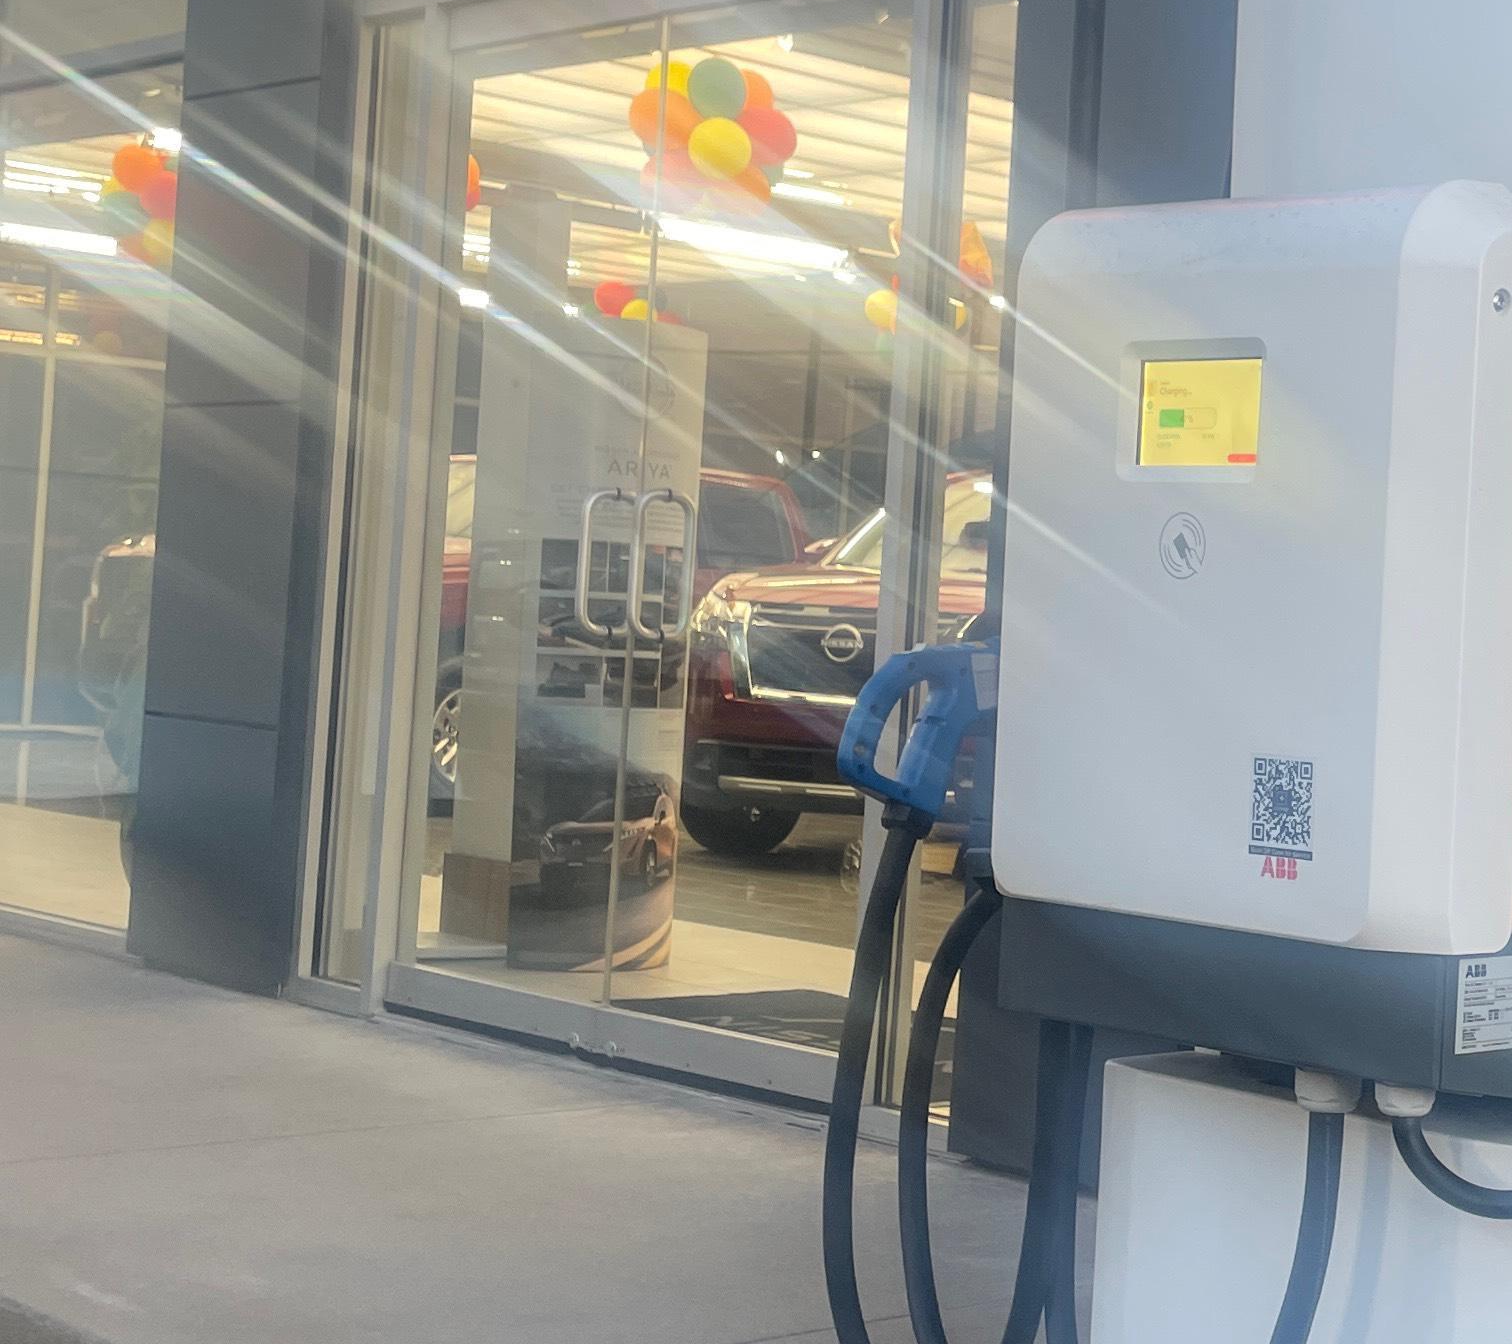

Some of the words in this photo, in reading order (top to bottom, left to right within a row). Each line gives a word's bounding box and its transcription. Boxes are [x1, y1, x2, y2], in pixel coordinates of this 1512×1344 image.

[607, 458, 671, 480] ARYA
[1260, 855, 1298, 880] ABB
[1465, 963, 1488, 978] ABB
